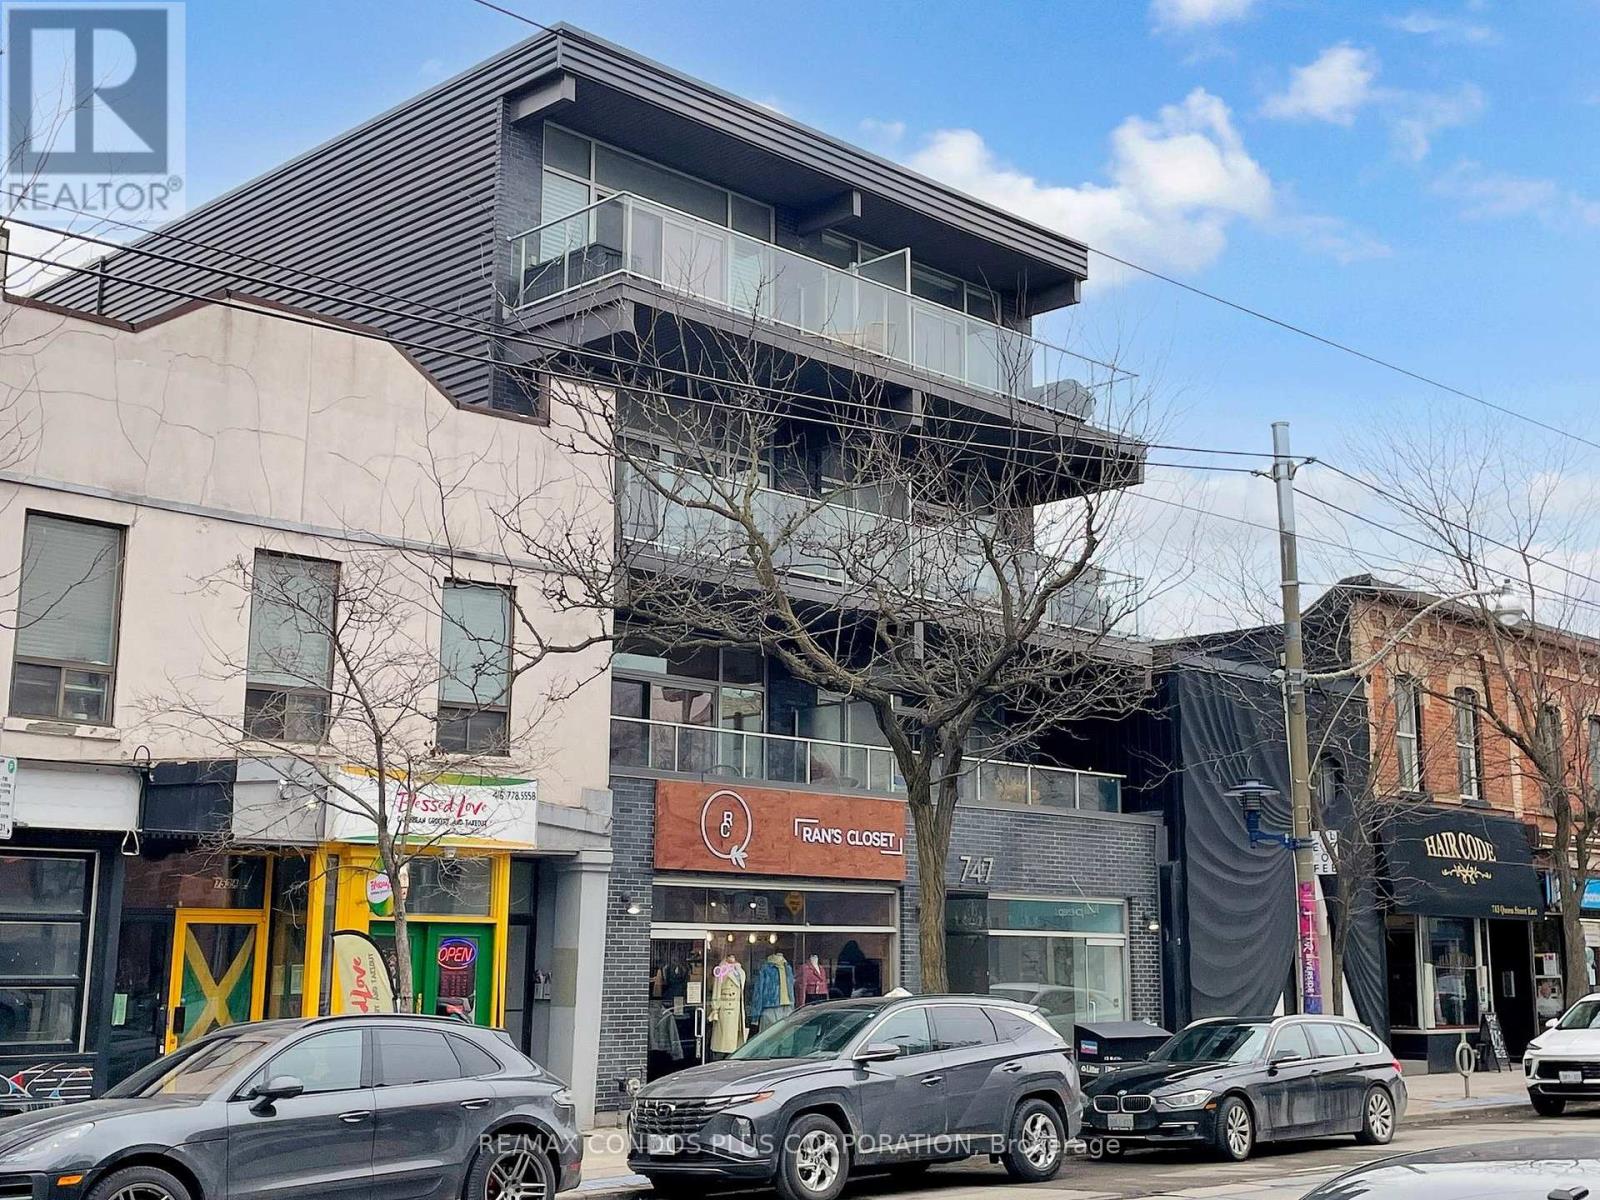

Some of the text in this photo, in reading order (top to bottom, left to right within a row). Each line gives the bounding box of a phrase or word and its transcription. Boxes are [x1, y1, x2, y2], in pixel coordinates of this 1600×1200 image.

[456, 793, 487, 818] Love
[802, 826, 896, 848] RAN'S CLOSET
[1424, 832, 1497, 862] HAIR CODE
[959, 855, 994, 884] 747
[438, 946, 472, 962] OPEN
